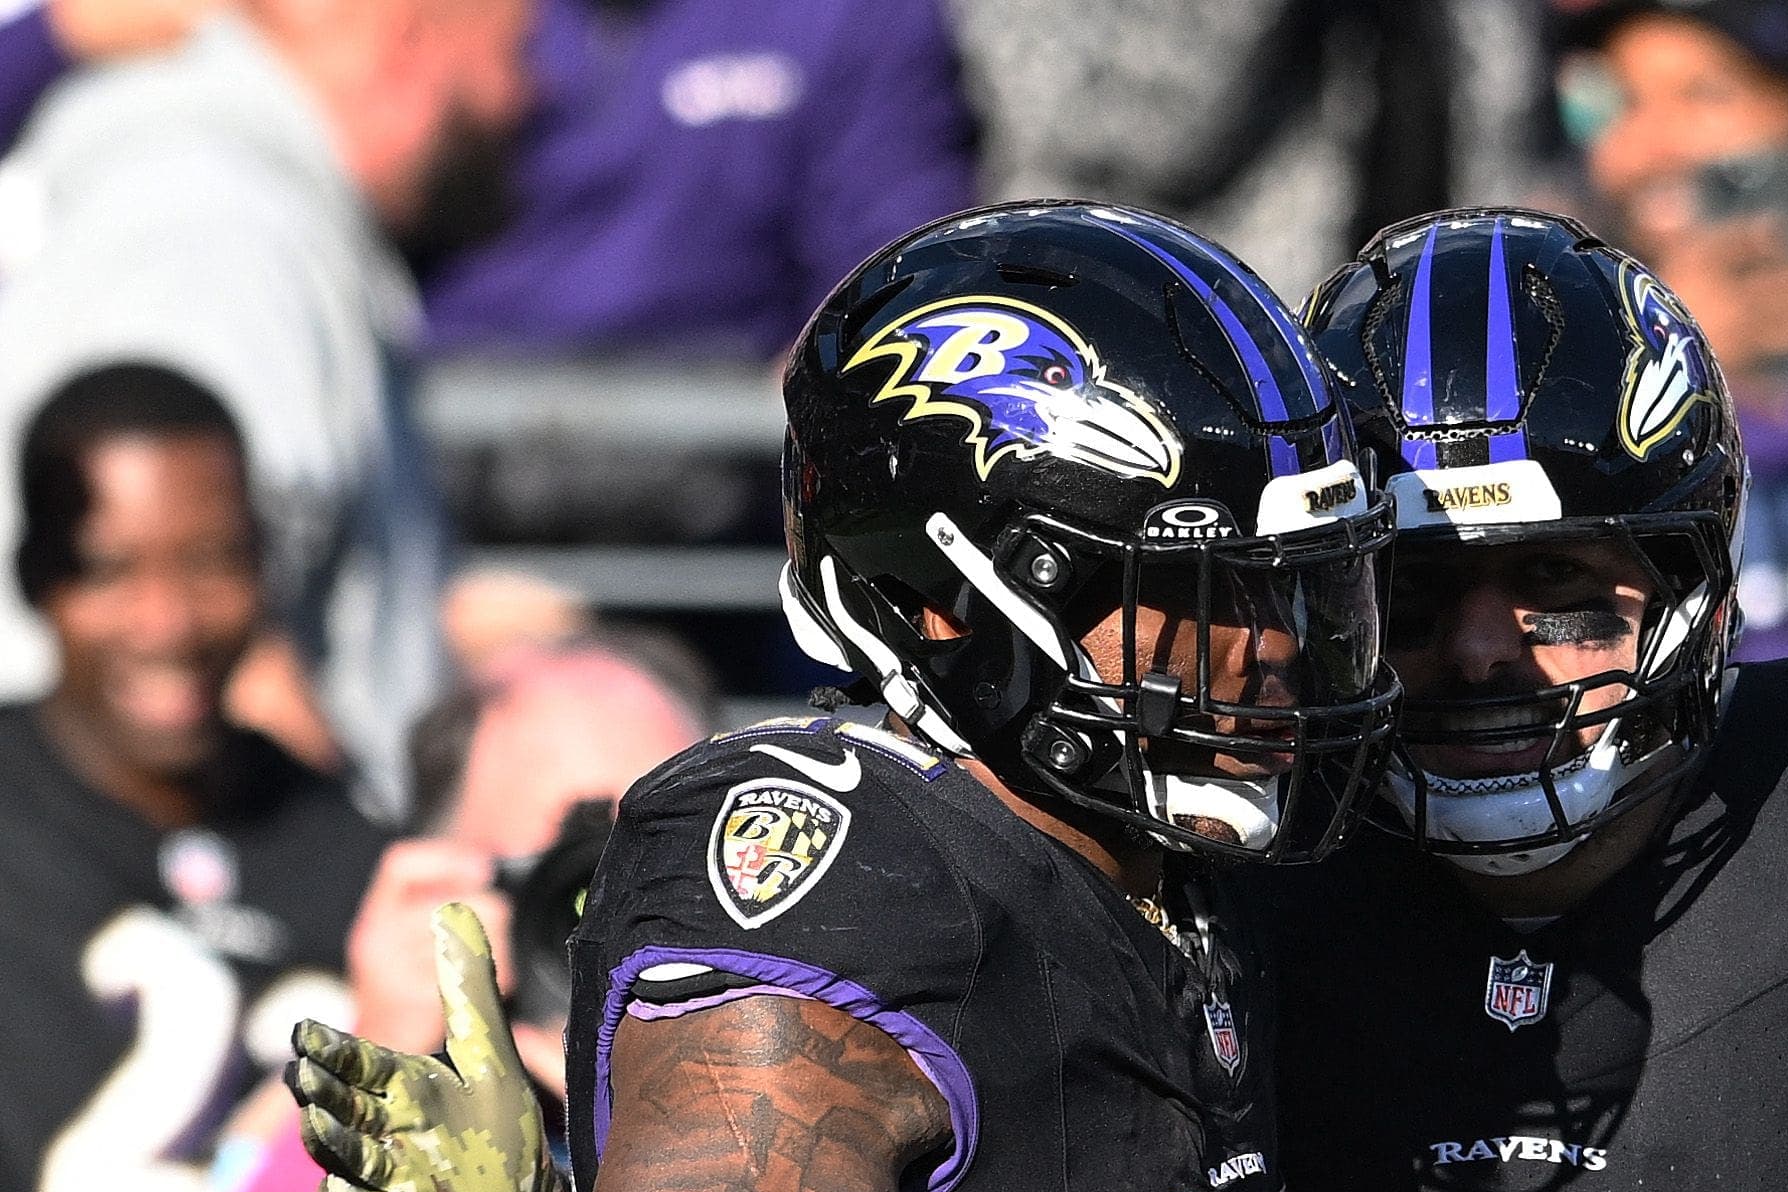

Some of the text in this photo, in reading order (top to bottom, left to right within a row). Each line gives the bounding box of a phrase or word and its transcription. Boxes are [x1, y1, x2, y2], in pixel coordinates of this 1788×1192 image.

[915, 310, 1031, 385] B
[1303, 478, 1357, 512] RAVENS
[1422, 482, 1512, 512] RAVENS
[1147, 526, 1233, 539] OAKLEY
[738, 790, 833, 823] RAVENS
[1493, 983, 1536, 1016] NFL
[1207, 1151, 1267, 1188] RAVEN
[1429, 1135, 1608, 1171] RAVENS
